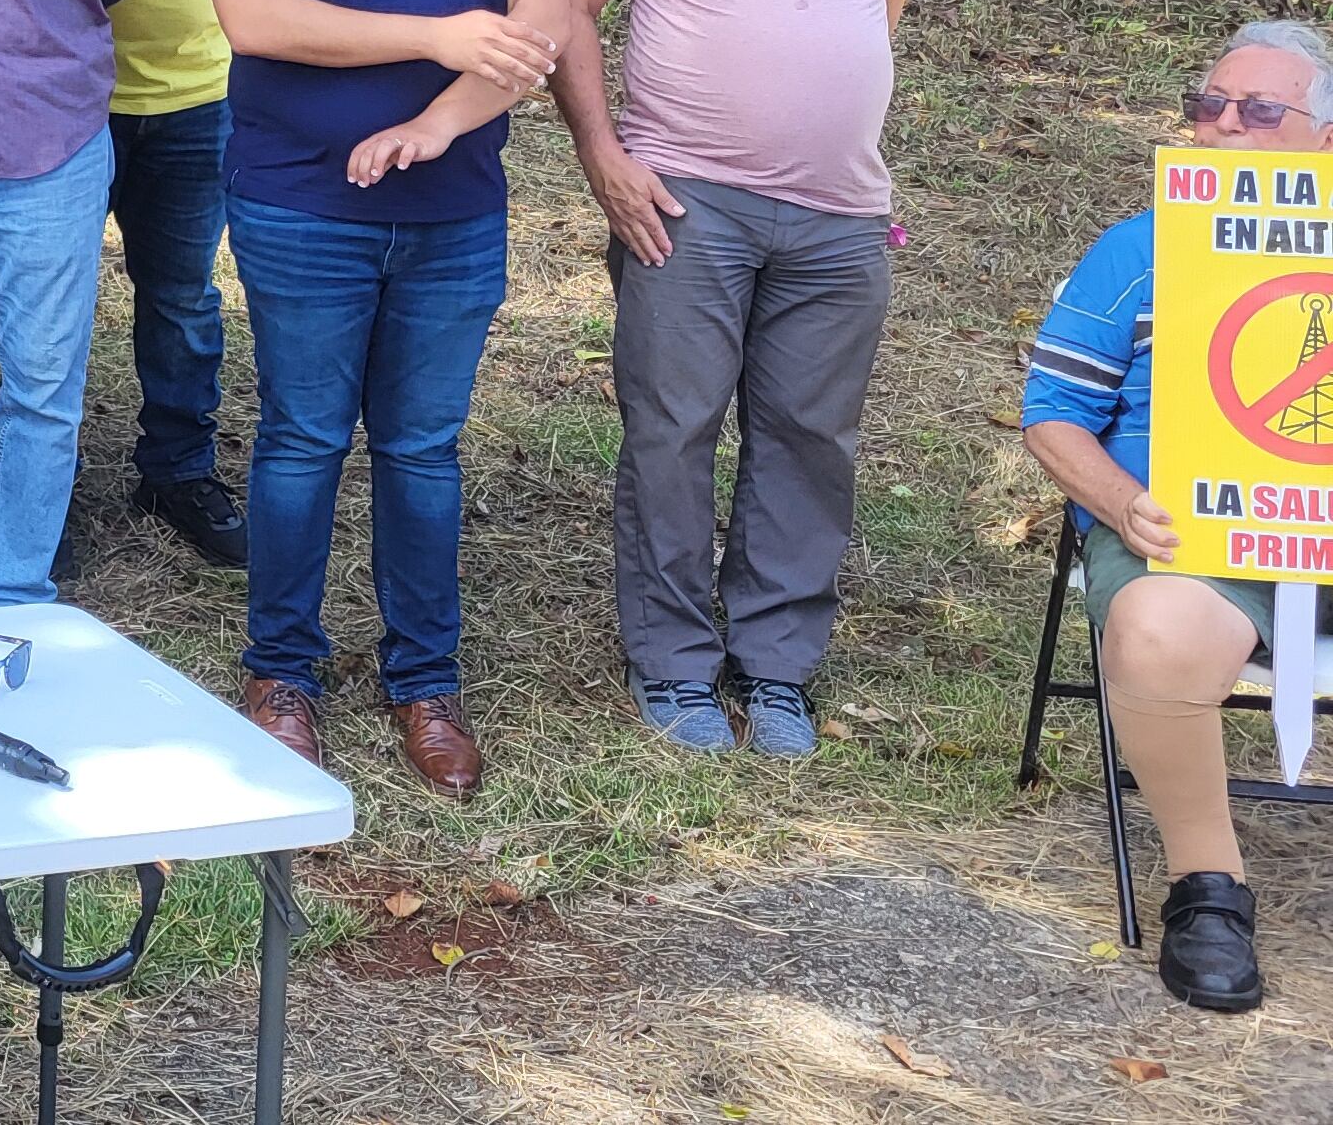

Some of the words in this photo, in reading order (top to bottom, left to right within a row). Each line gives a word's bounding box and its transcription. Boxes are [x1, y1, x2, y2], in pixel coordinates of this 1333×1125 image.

[1168, 167, 1217, 201] NO
[1234, 170, 1258, 203] A
[1276, 172, 1317, 205] LA
[1215, 217, 1257, 251] EN
[1265, 220, 1333, 254] ALT
[1196, 482, 1243, 517] LA
[1253, 486, 1333, 522] SAL
